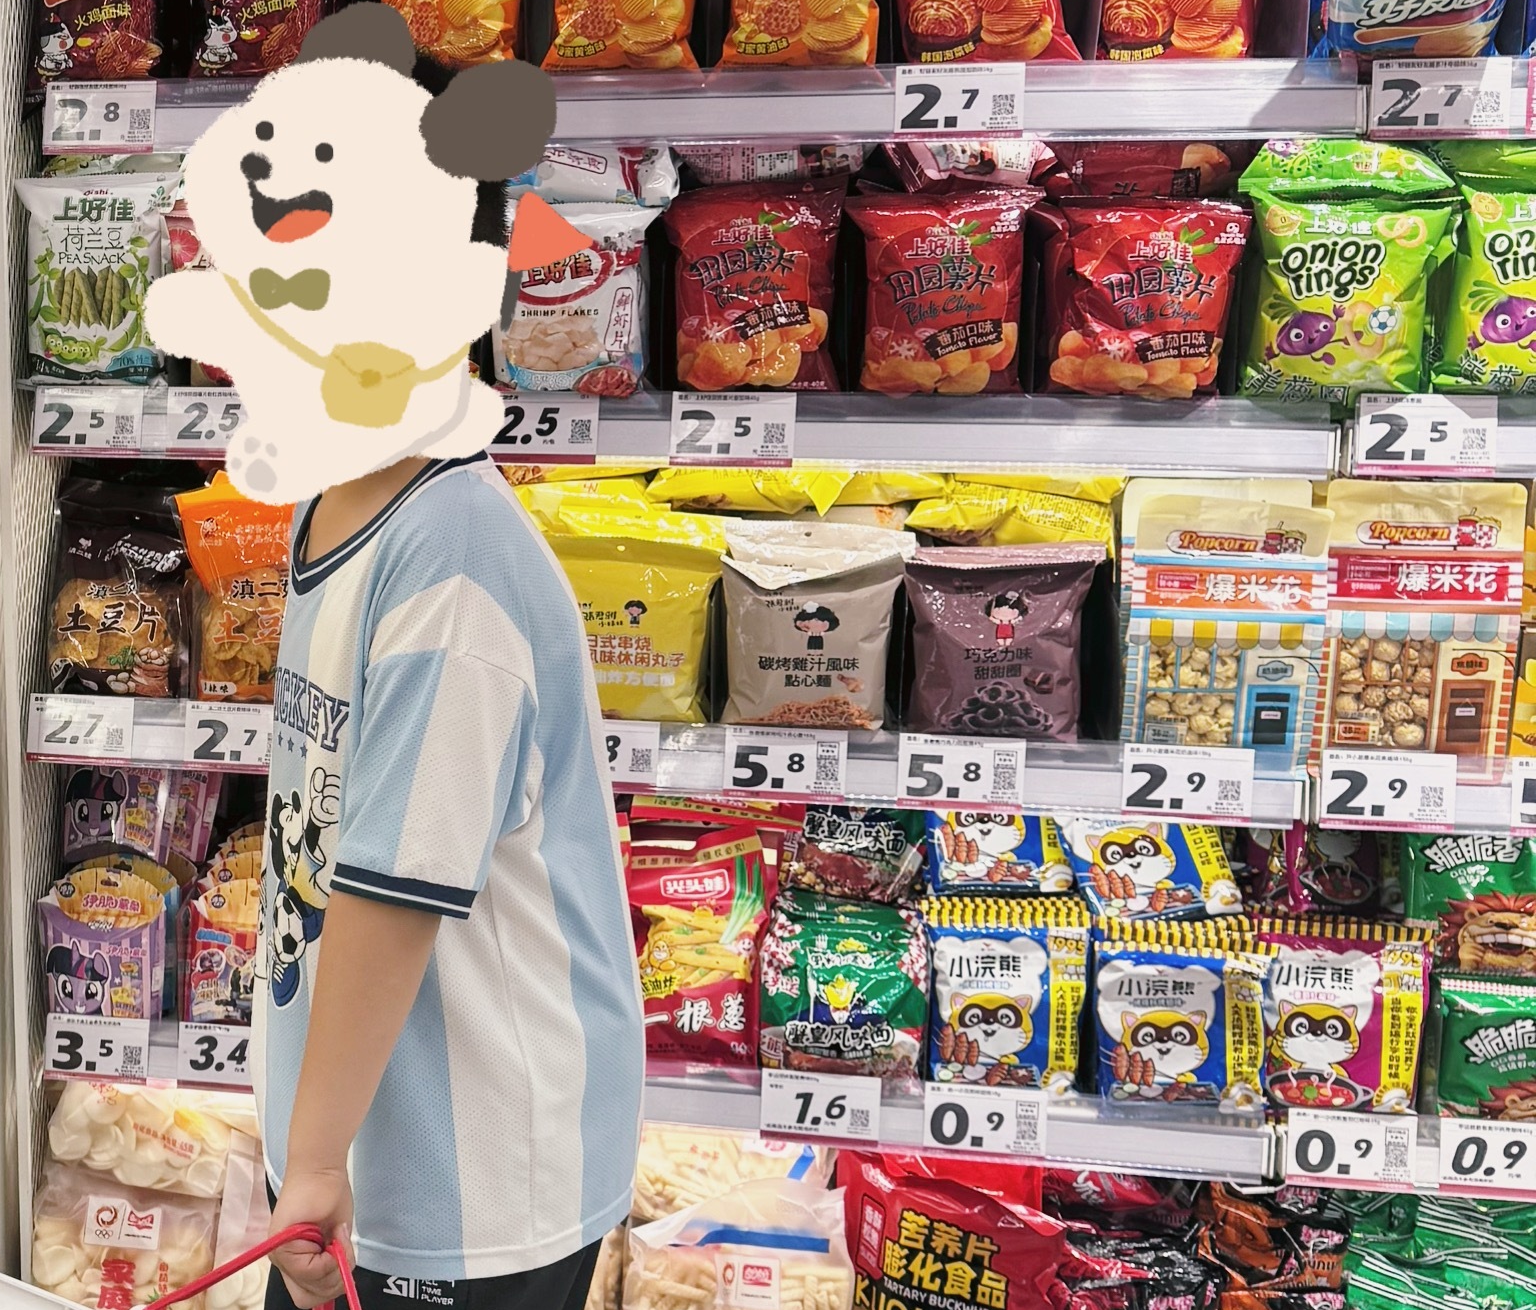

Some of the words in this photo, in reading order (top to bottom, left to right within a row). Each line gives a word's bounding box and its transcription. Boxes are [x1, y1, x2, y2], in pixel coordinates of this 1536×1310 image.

[51, 99, 120, 142] 2.8
[899, 84, 979, 131] 2.7
[1377, 78, 1463, 127] 2.7
[53, 196, 136, 223] 上好佳
[936, 321, 995, 347] 番茄口味
[1148, 330, 1208, 351] 番茄口味
[38, 403, 105, 445] 2.5
[177, 402, 241, 441] 2.5
[676, 410, 752, 455] 2.5
[1365, 413, 1448, 461] 2.5
[1370, 520, 1451, 543] Popcorn
[1203, 573, 1304, 605] 爆米花
[1397, 563, 1498, 596] 爆米花
[44, 713, 103, 747] 2.7
[274, 666, 350, 753] ICKEY
[194, 718, 257, 762] 2.7
[731, 746, 805, 788] 5.8
[907, 754, 982, 798] 5.8
[1125, 763, 1206, 811] 2.9
[1326, 769, 1408, 817] 2.9
[947, 953, 1023, 980] 小浣熊
[1117, 976, 1196, 998] 小浣熊
[1275, 960, 1354, 992] 小浣熊
[52, 1031, 114, 1071] 3.5
[189, 1035, 249, 1071] 3.4
[793, 1092, 846, 1128] 1.6
[930, 1102, 1004, 1148] 0.9
[1294, 1129, 1373, 1175] 0.9
[1451, 1136, 1527, 1177] 0.9
[883, 1238, 1009, 1310] 膨化食品
[883, 1277, 927, 1302] TARTARY
